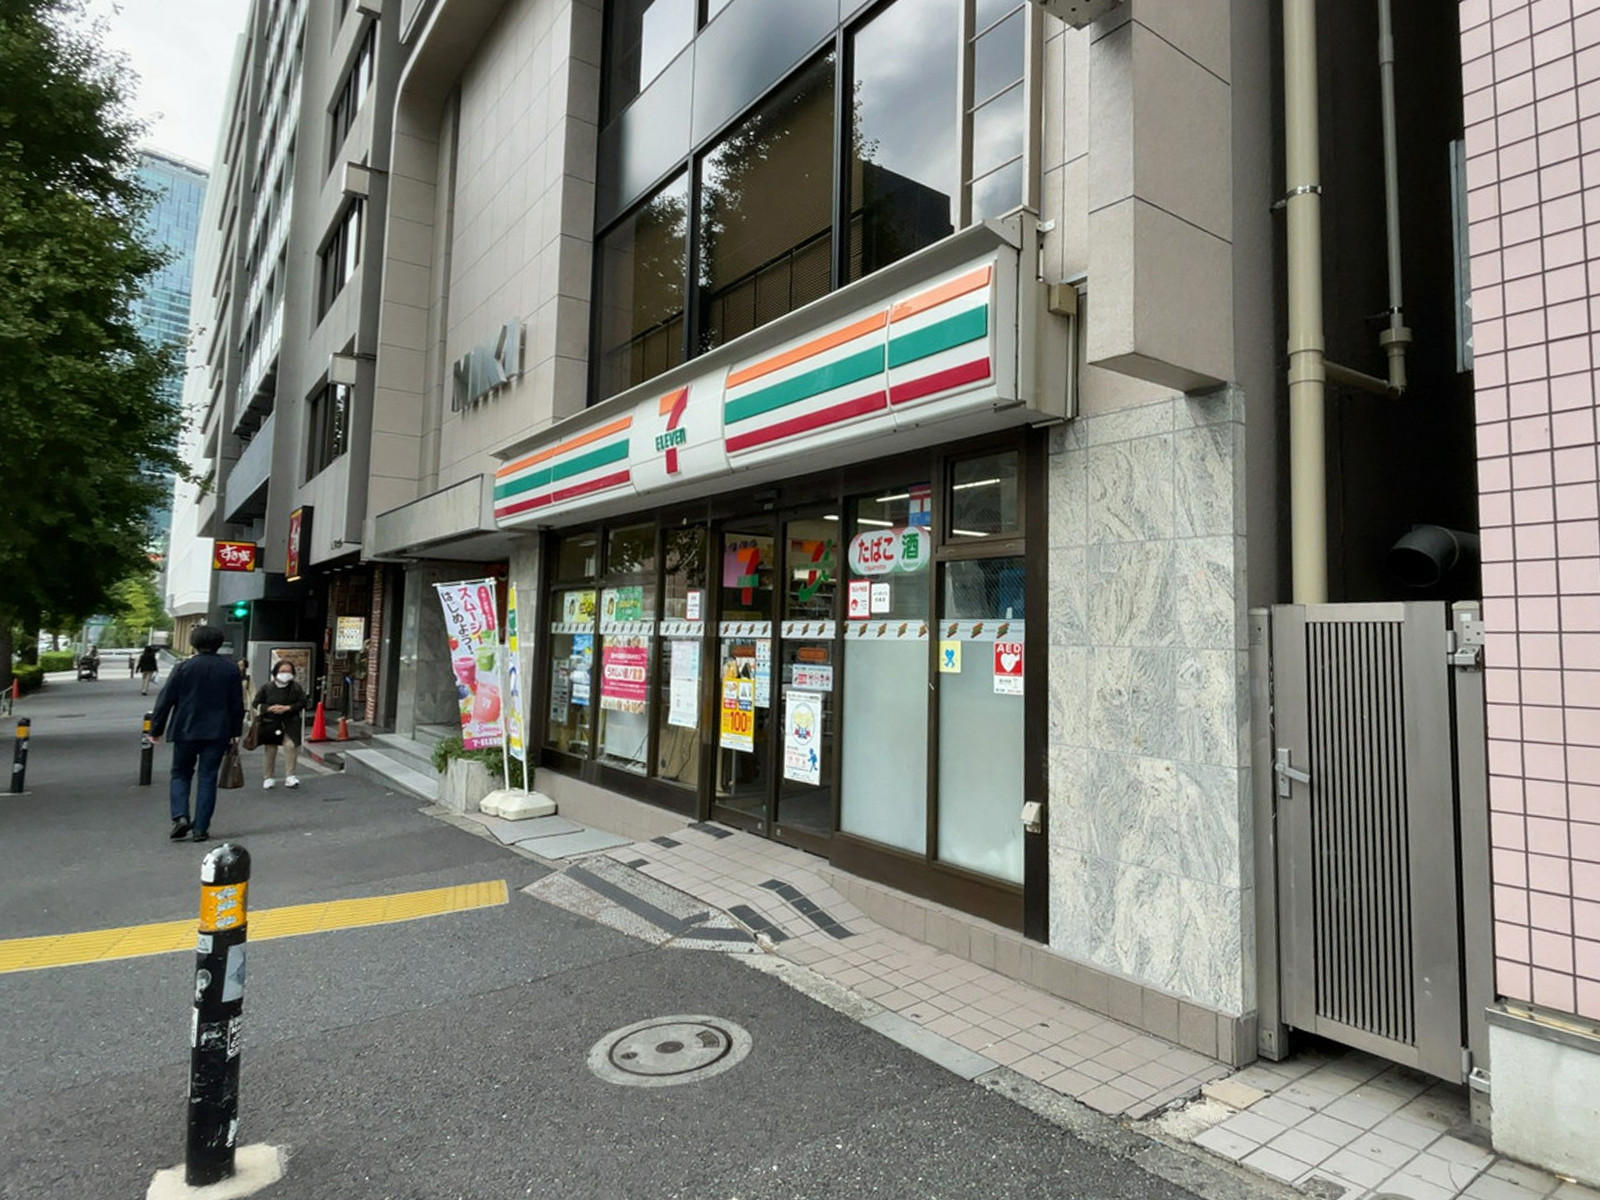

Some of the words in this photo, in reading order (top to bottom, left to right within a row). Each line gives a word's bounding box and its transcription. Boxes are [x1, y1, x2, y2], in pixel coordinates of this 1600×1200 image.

[858, 536, 894, 564] たばこ
[902, 533, 919, 560] 酒
[458, 587, 483, 645] スムージー
[997, 643, 1021, 653] AED
[731, 711, 748, 732] 100
